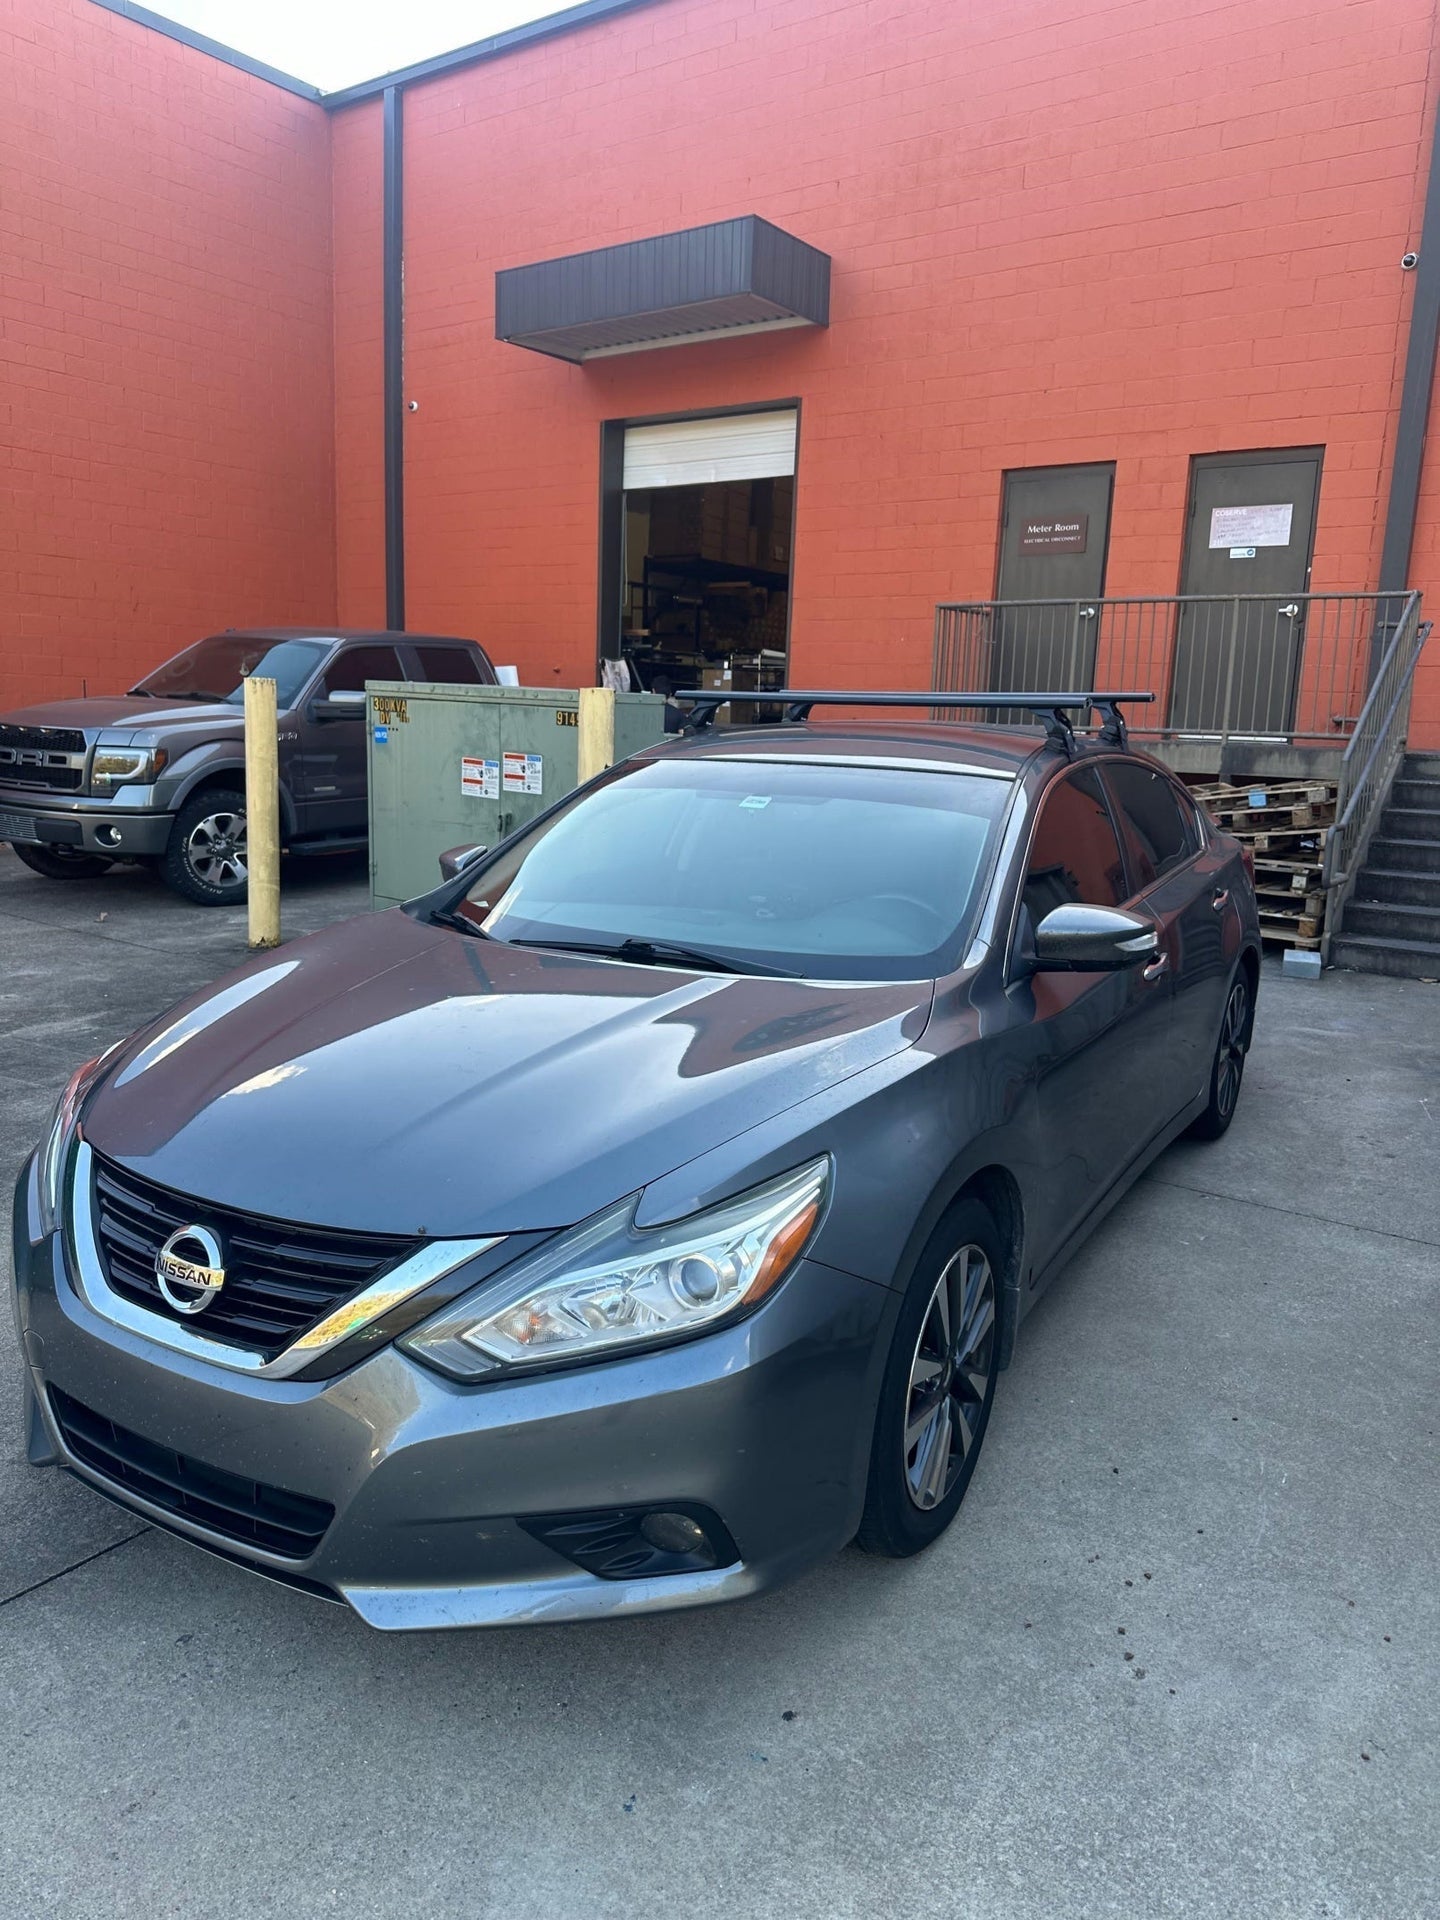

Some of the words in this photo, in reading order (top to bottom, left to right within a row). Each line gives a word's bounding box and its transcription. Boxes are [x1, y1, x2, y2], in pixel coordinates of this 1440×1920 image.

[1027, 524, 1053, 534] Meter
[1054, 523, 1080, 532] Room
[374, 697, 407, 712] 300KVA
[557, 711, 579, 727] 914
[156, 1255, 212, 1286] NISSAN
